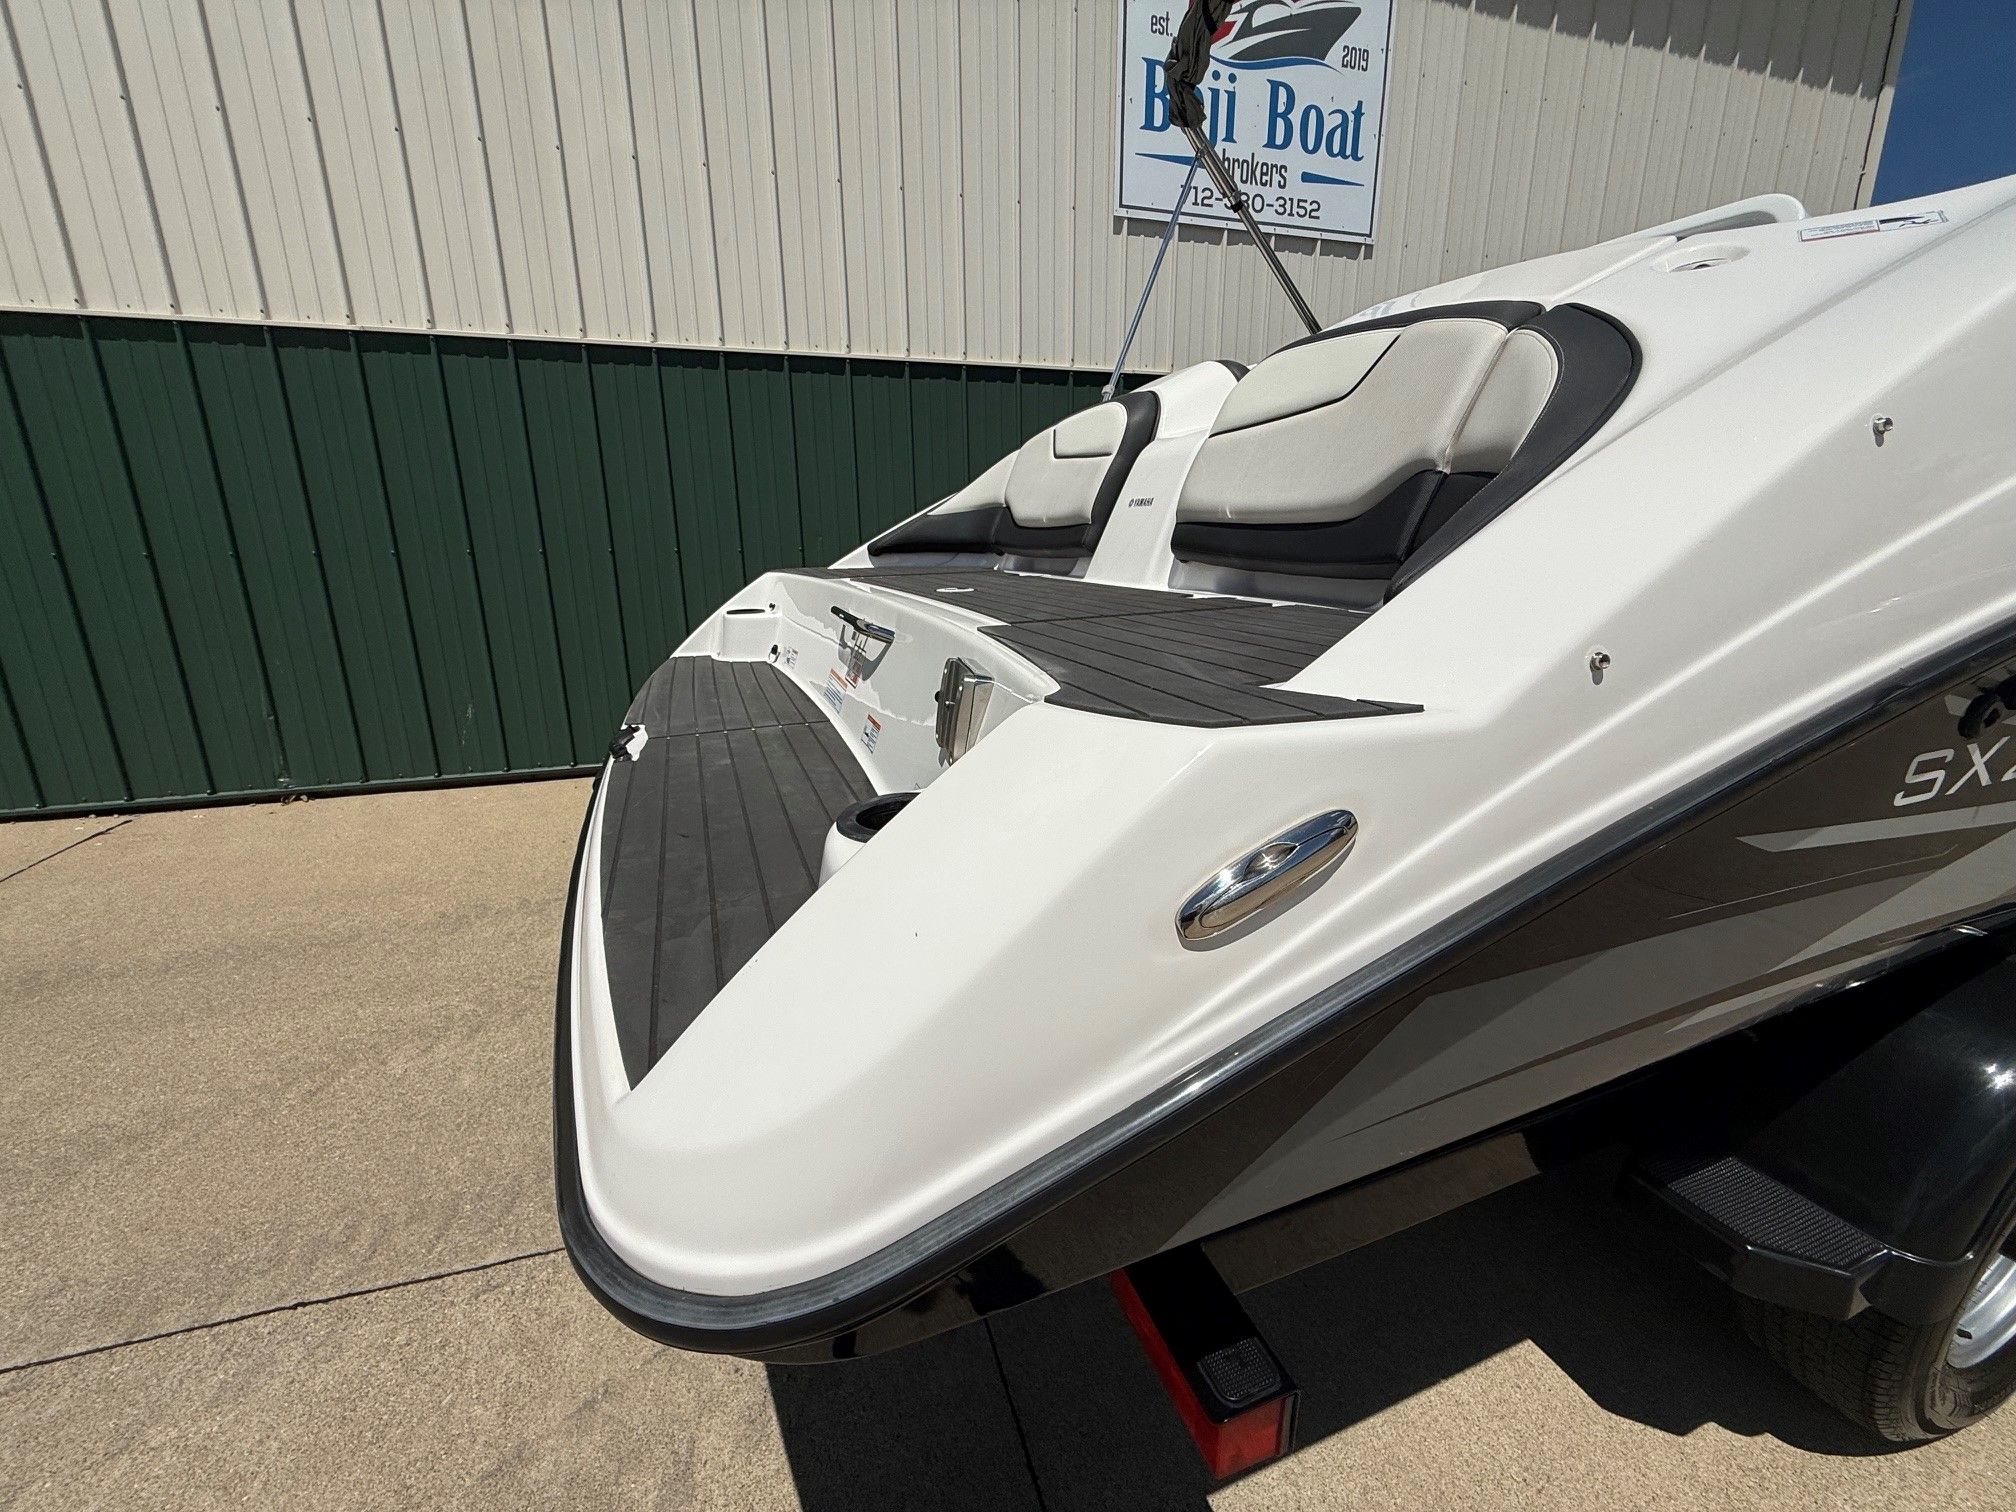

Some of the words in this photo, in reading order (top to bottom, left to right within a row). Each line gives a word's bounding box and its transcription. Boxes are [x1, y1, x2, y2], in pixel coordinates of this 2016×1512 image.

[1150, 11, 1174, 37] est.
[1341, 45, 1370, 72] 2019
[1139, 56, 1238, 151] Bji
[1262, 78, 1366, 162] Boat
[1221, 148, 1288, 190] brokers
